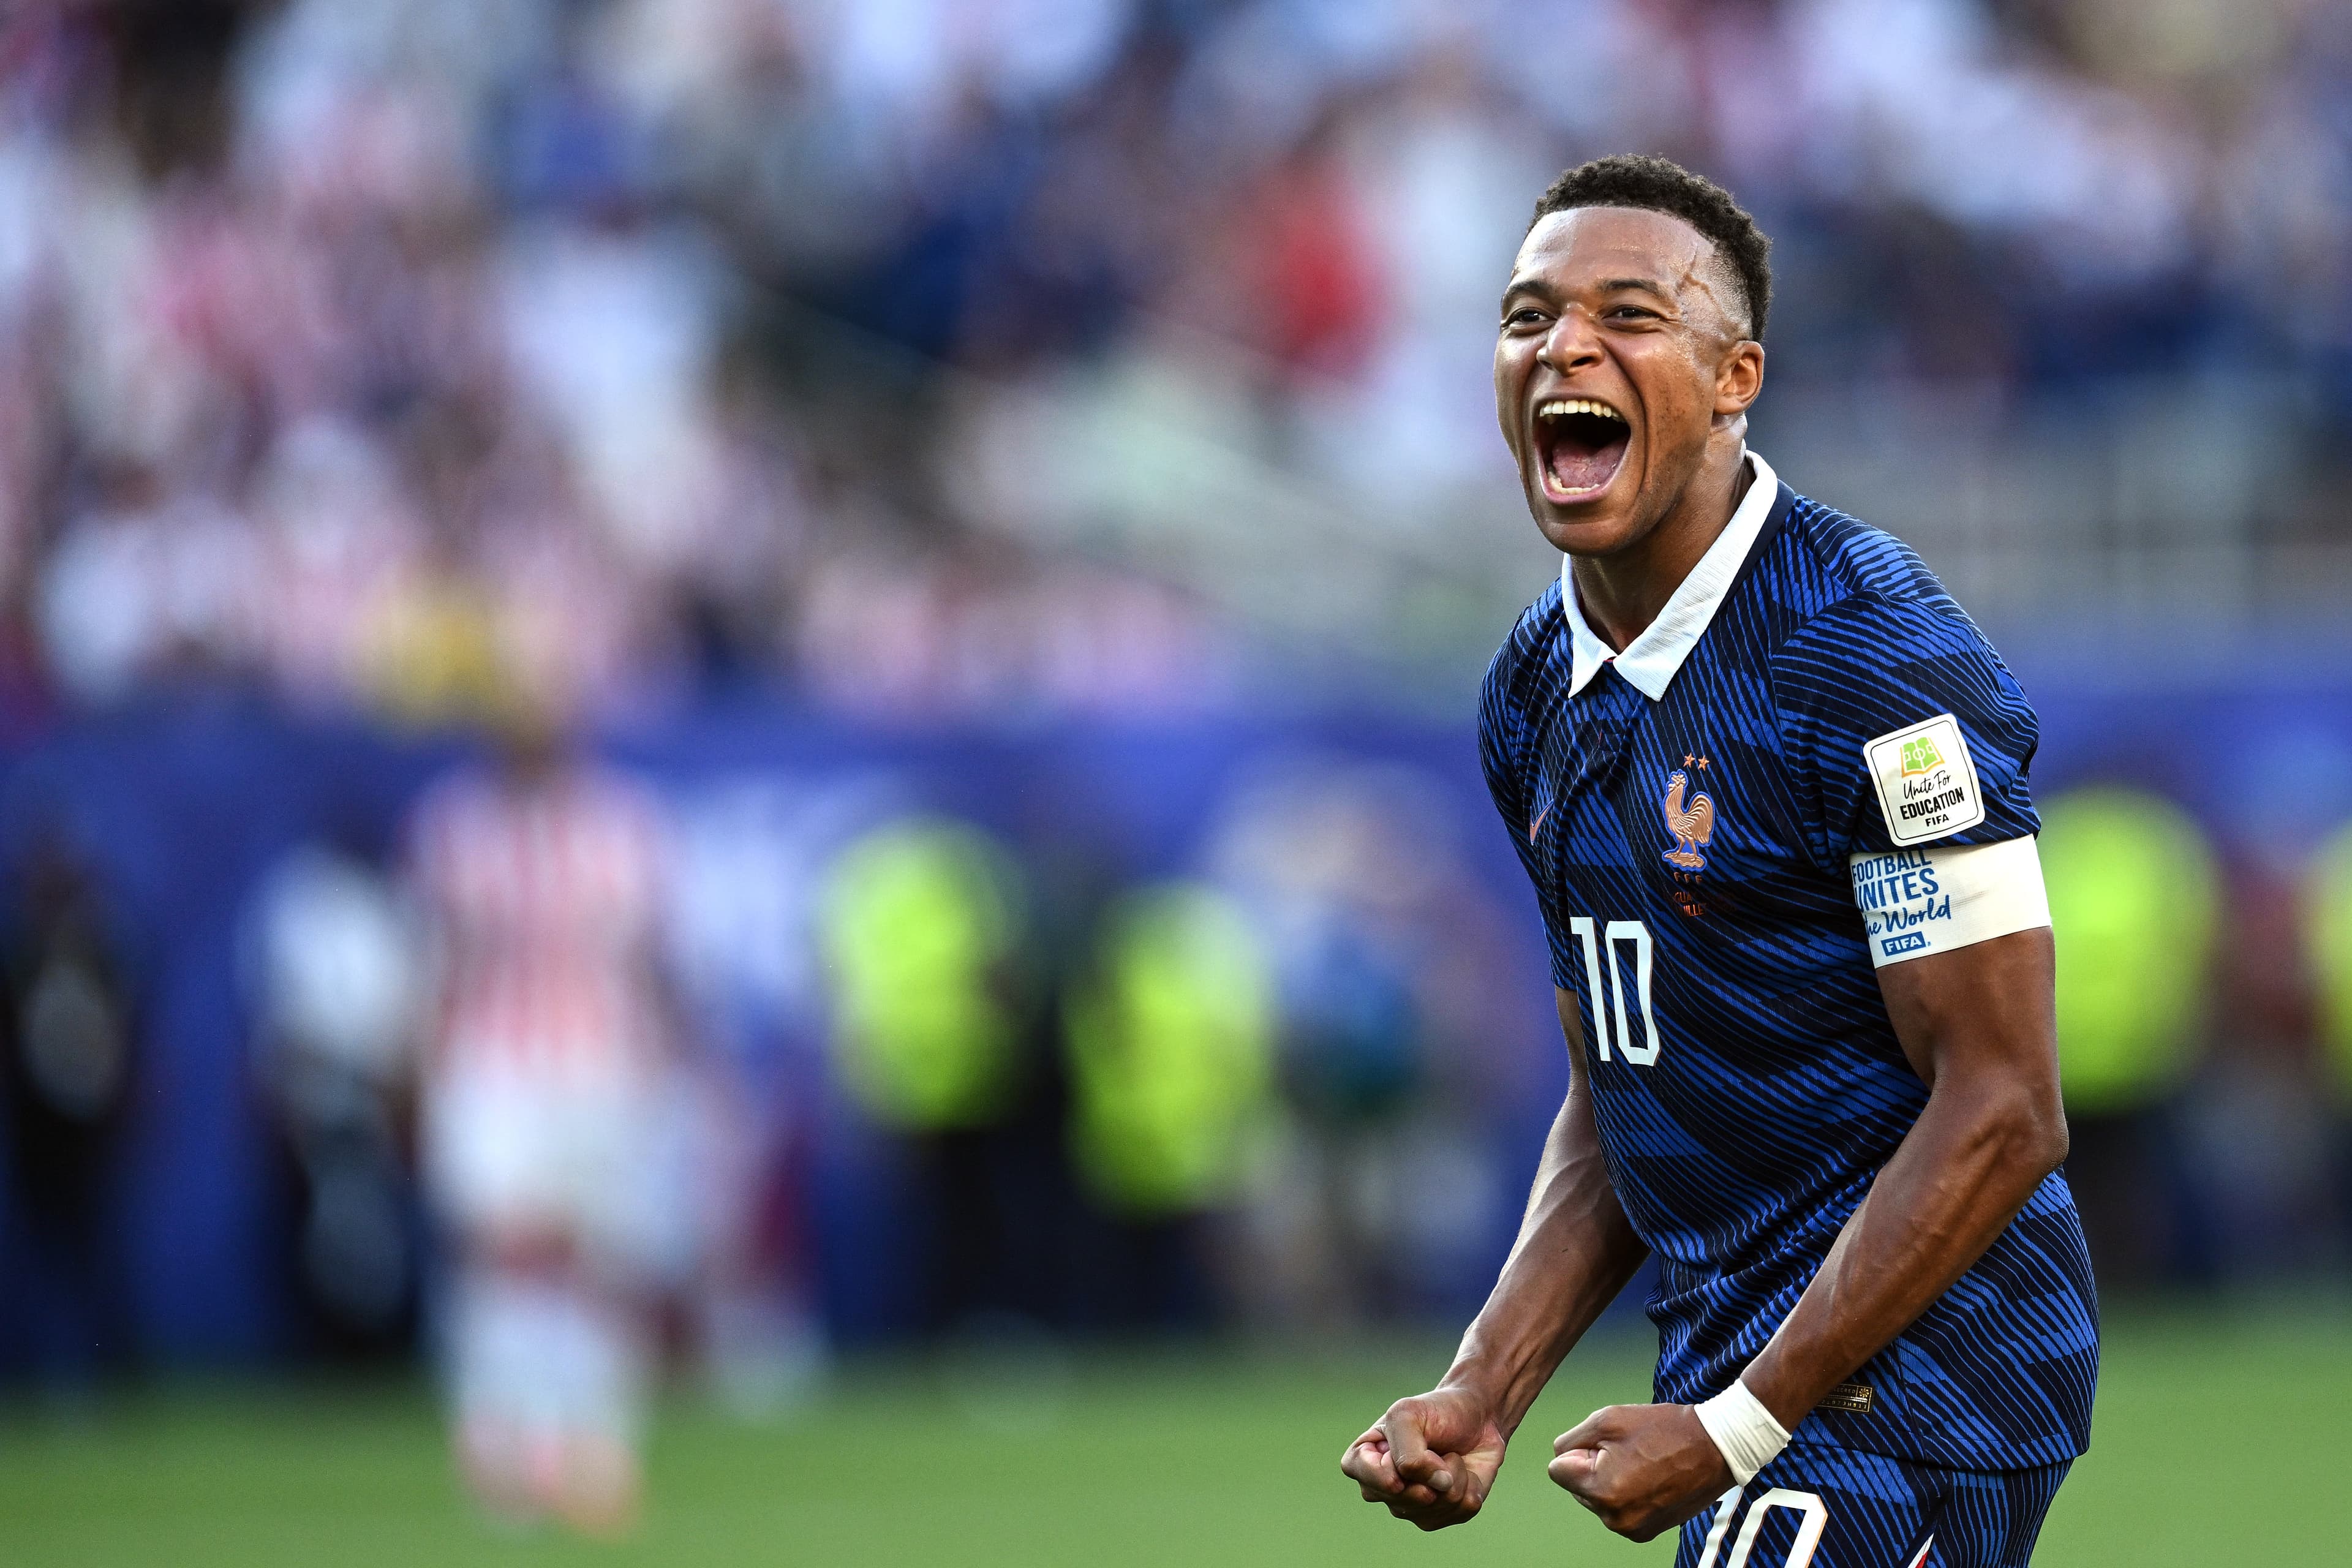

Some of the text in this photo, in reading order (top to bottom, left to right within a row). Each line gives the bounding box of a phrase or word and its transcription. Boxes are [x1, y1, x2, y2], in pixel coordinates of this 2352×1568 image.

[1904, 770, 1951, 800] Unite For
[1899, 786, 1964, 820] EDUCATION
[1925, 814, 1949, 827] FIFA
[1852, 850, 1932, 885] FOOTBALL
[1855, 868, 1939, 913] UNITES
[1881, 894, 1951, 932] World
[1885, 935, 1922, 953] FIFA
[1569, 916, 1662, 1067] 10
[1697, 1485, 1828, 1568] 10
